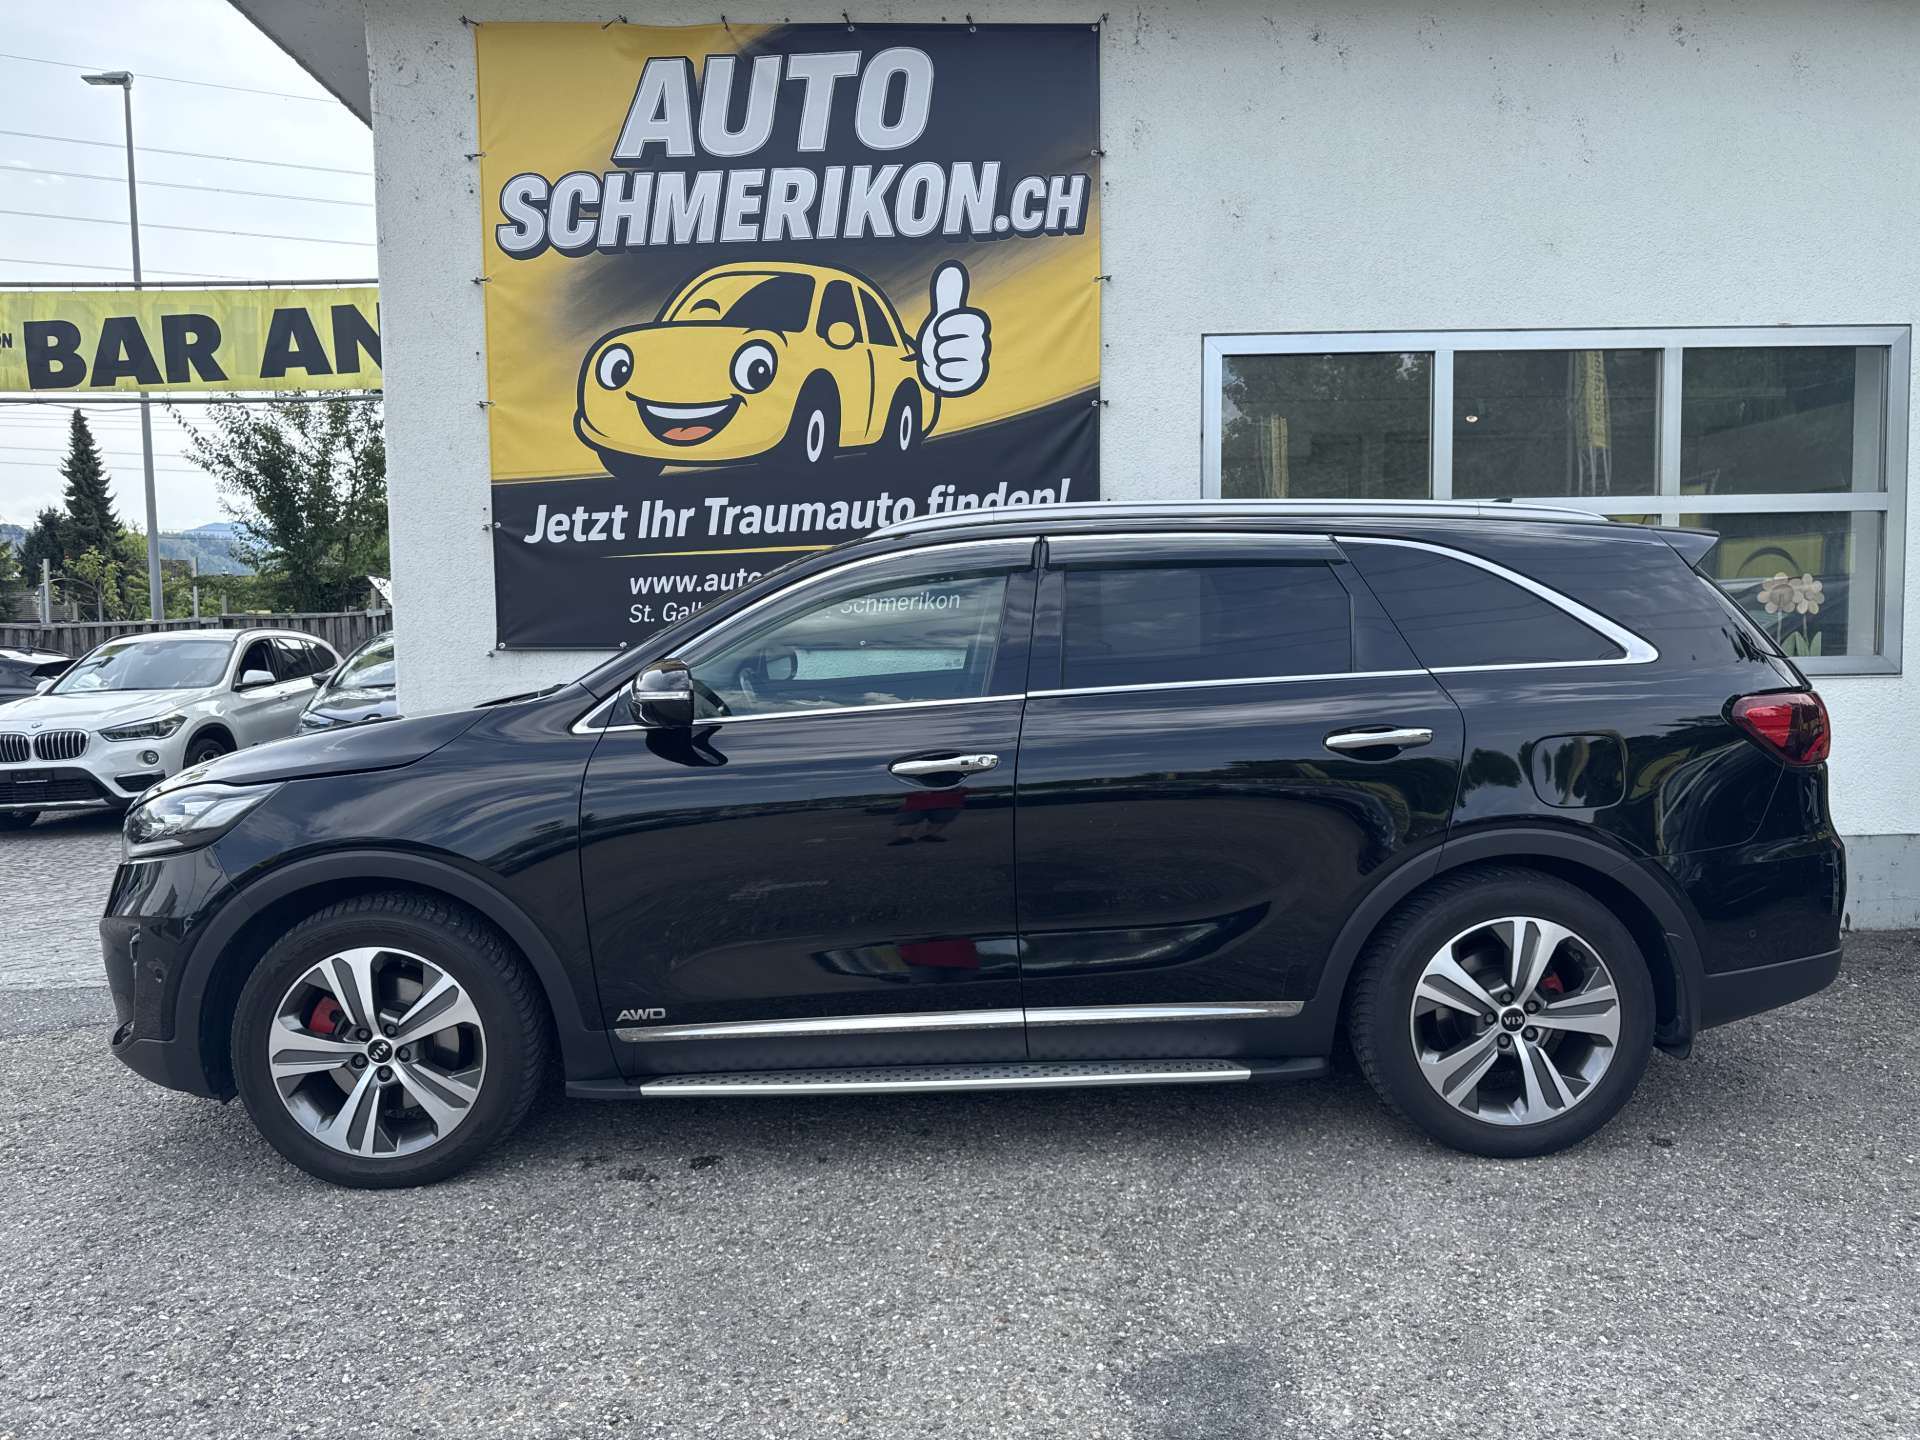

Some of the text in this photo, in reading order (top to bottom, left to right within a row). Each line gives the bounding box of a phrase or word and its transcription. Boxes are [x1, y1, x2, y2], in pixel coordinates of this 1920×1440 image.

[614, 46, 934, 160] AUTO
[497, 162, 1088, 252] SCHMERIKON.CH
[23, 313, 229, 390] BAR
[523, 504, 629, 544] Jetzt
[638, 500, 696, 539] Ihr
[704, 492, 916, 536] Traumauto
[629, 604, 655, 624] St.
[616, 1008, 666, 1022] AWD
[1503, 1015, 1524, 1026] KIA
